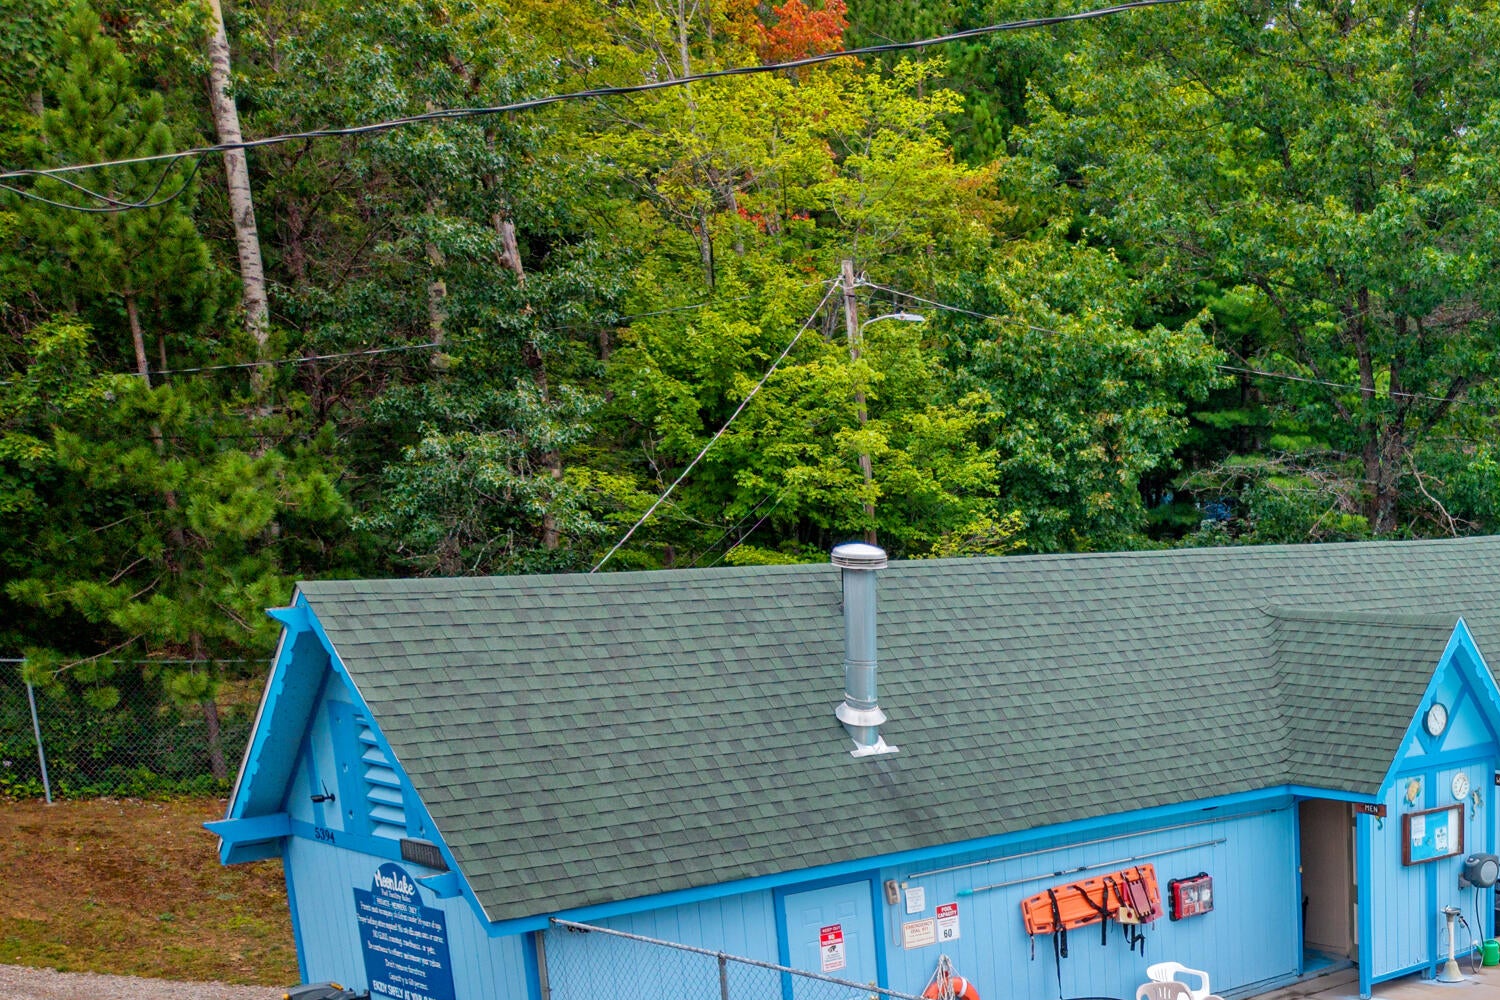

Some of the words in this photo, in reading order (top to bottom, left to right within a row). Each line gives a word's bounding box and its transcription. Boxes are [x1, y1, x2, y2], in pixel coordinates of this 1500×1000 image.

[1364, 804, 1378, 813] MEN
[315, 827, 336, 844] 5394
[374, 869, 394, 890] Moon
[392, 871, 416, 896] Lake
[943, 928, 953, 938] 60
